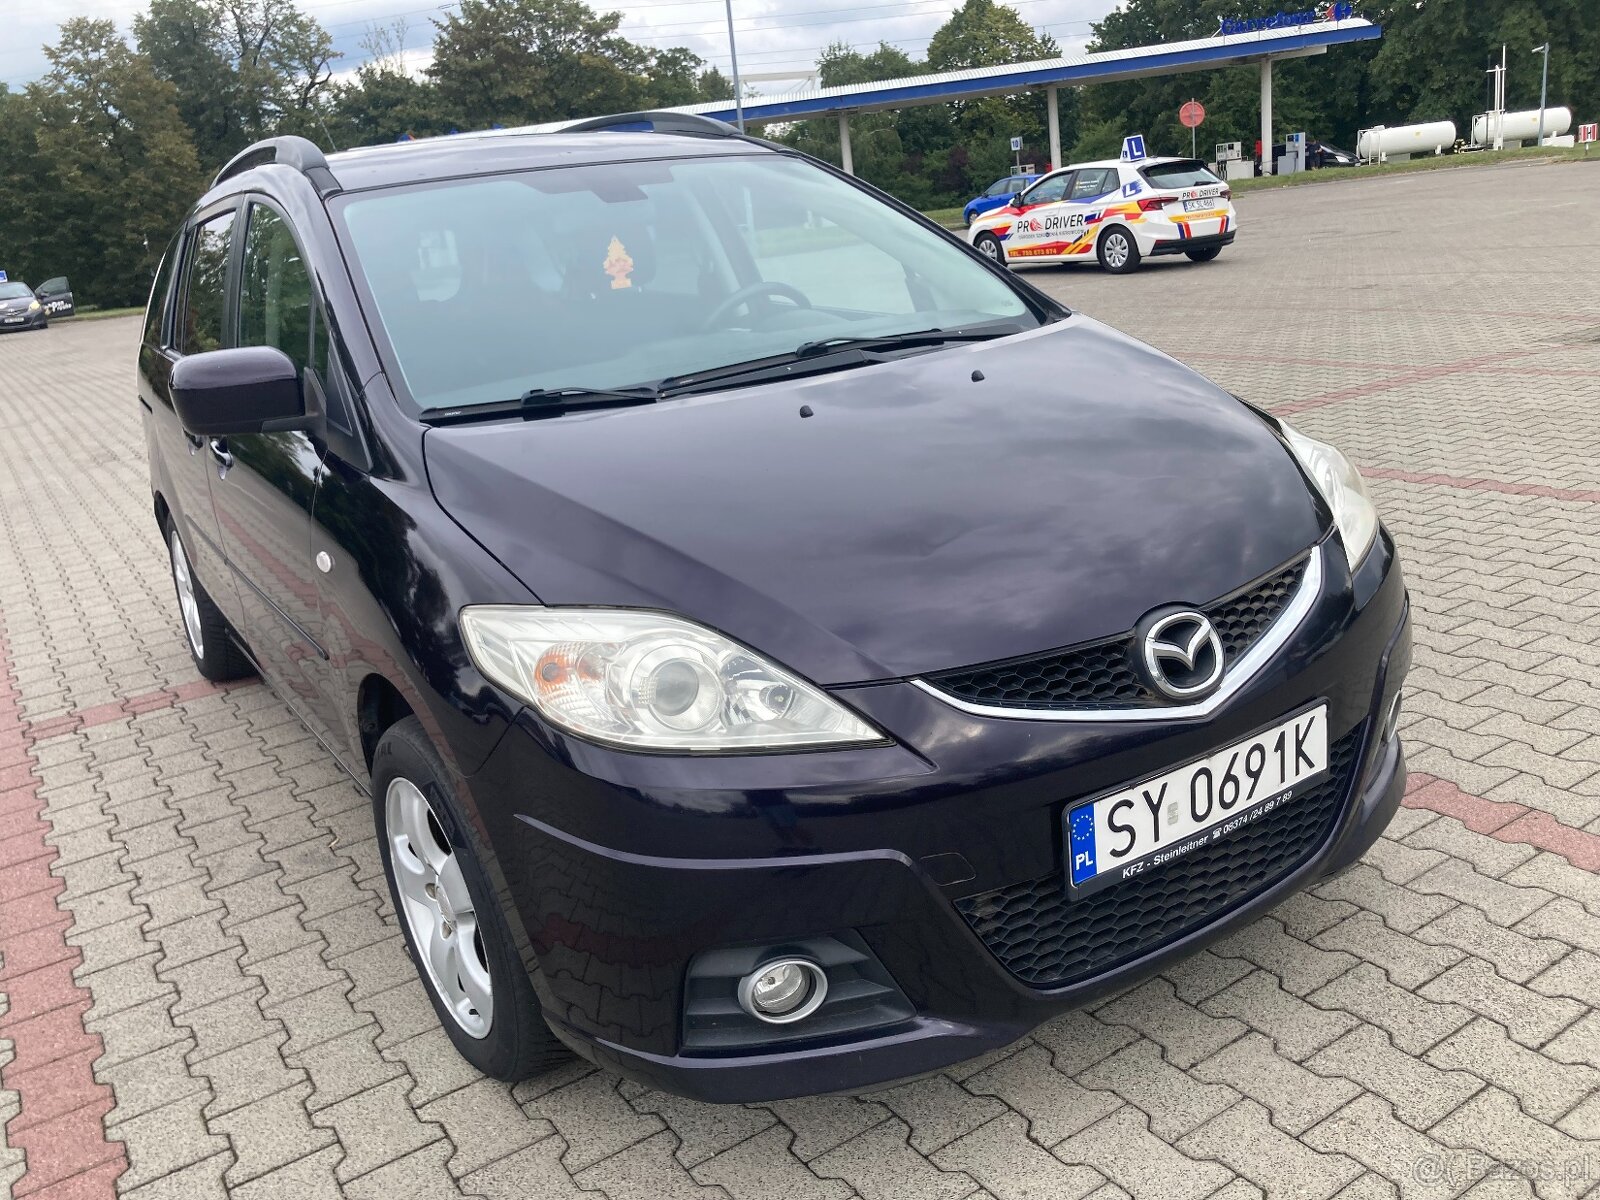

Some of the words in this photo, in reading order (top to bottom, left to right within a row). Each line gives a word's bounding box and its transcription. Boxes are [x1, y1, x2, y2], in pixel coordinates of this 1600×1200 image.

[1131, 140, 1142, 156] L
[1199, 188, 1219, 198] DRIVER
[1044, 214, 1084, 230] DRIVER
[1107, 782, 1168, 858] SY
[1190, 715, 1316, 823] 0691K
[1075, 851, 1094, 870] PL
[1122, 861, 1144, 879] KFZ
[1153, 835, 1209, 865] Steinleitner
